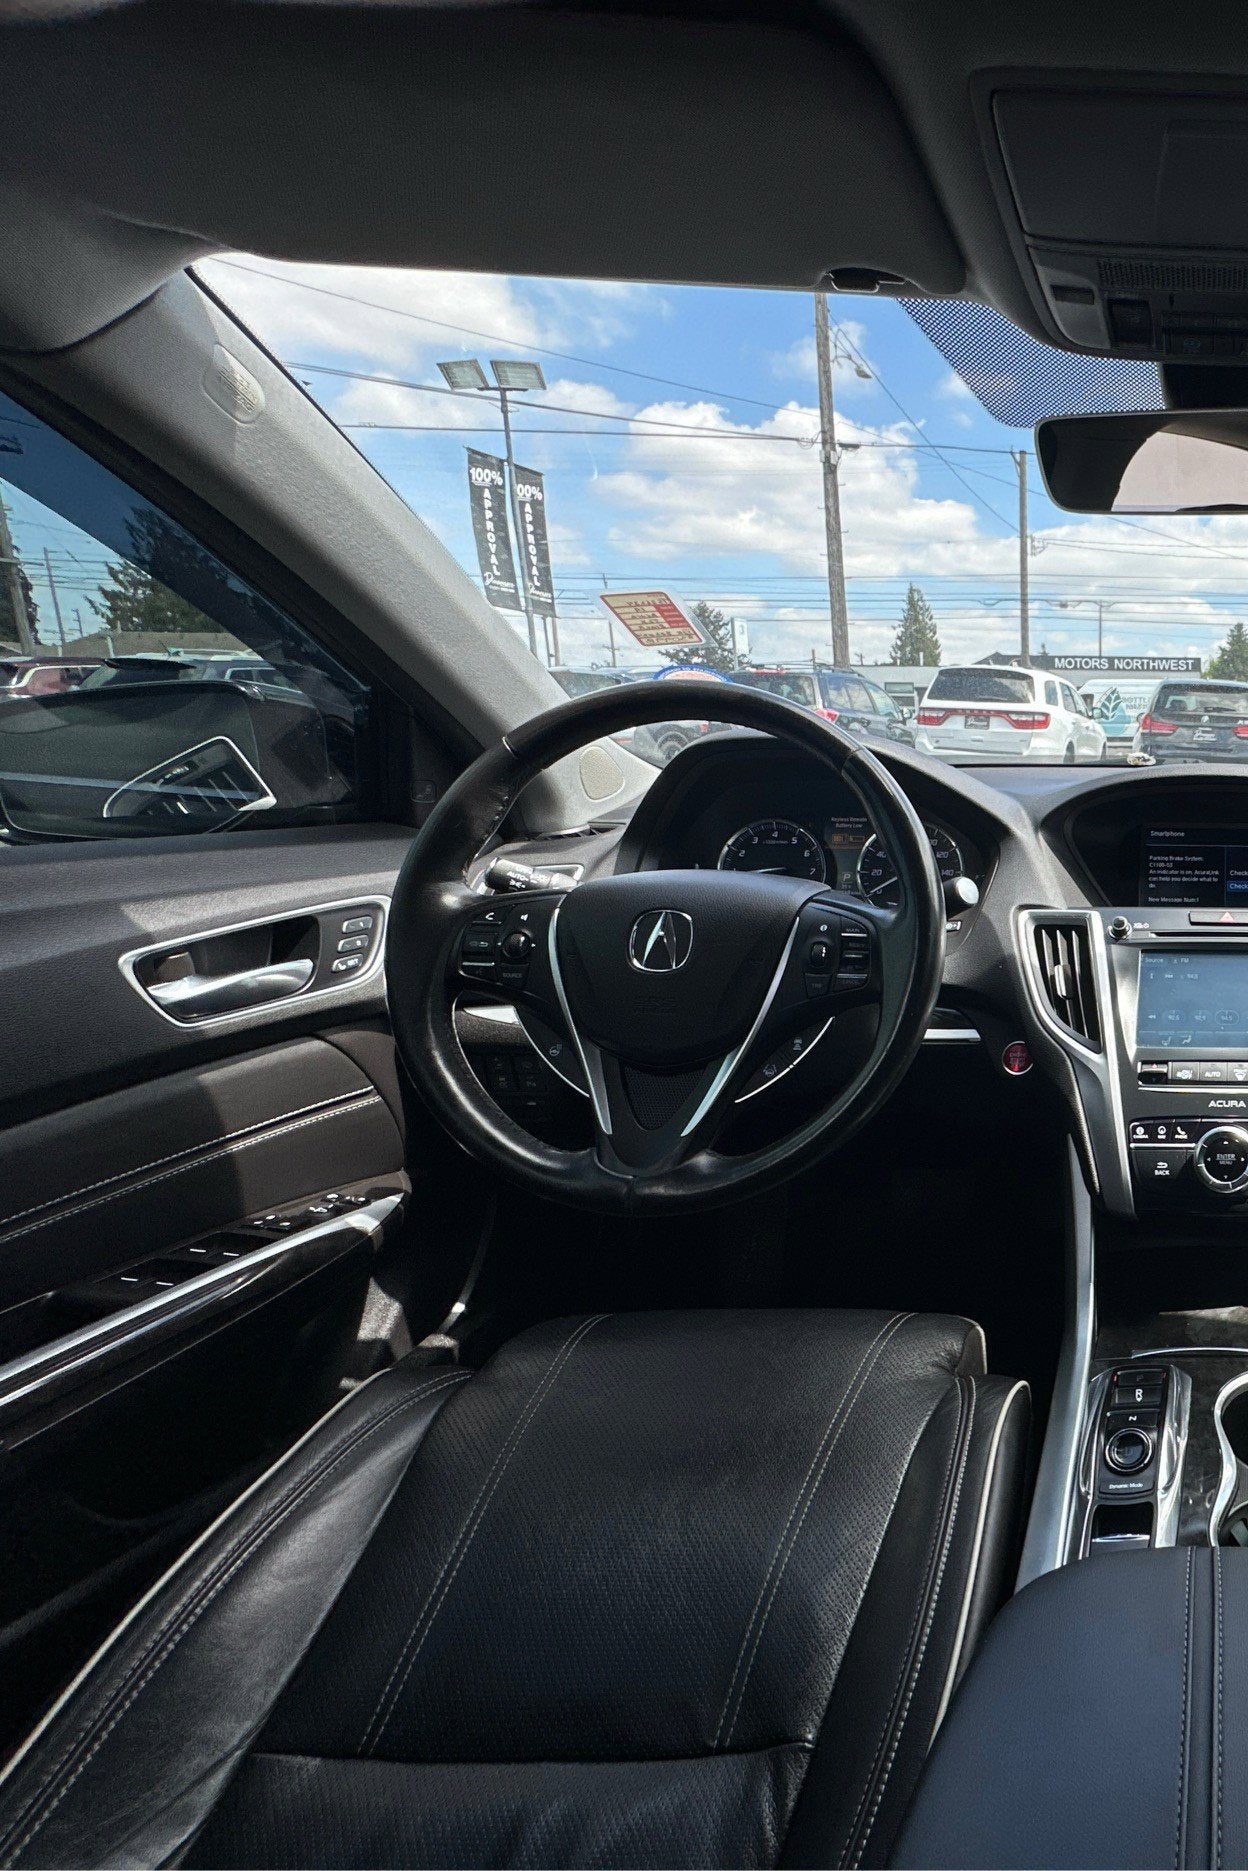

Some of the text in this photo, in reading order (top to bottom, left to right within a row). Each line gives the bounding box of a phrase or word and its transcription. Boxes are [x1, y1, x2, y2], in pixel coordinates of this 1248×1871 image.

[470, 467, 504, 486] 100%
[516, 484, 543, 501] 00%
[484, 488, 500, 576] APPROVAL
[525, 502, 540, 587] APPROVAL
[1054, 657, 1194, 671] MOTORS NORTHWEST
[1150, 830, 1185, 838] Smartphone
[752, 836, 759, 844] 3
[791, 836, 797, 844] 5
[739, 849, 745, 857] 2
[810, 867, 816, 875] 7
[843, 873, 851, 881] P
[1208, 1100, 1247, 1108] ACURA
[1135, 1388, 1143, 1398] R
[1109, 1482, 1129, 1490] Dynamic
